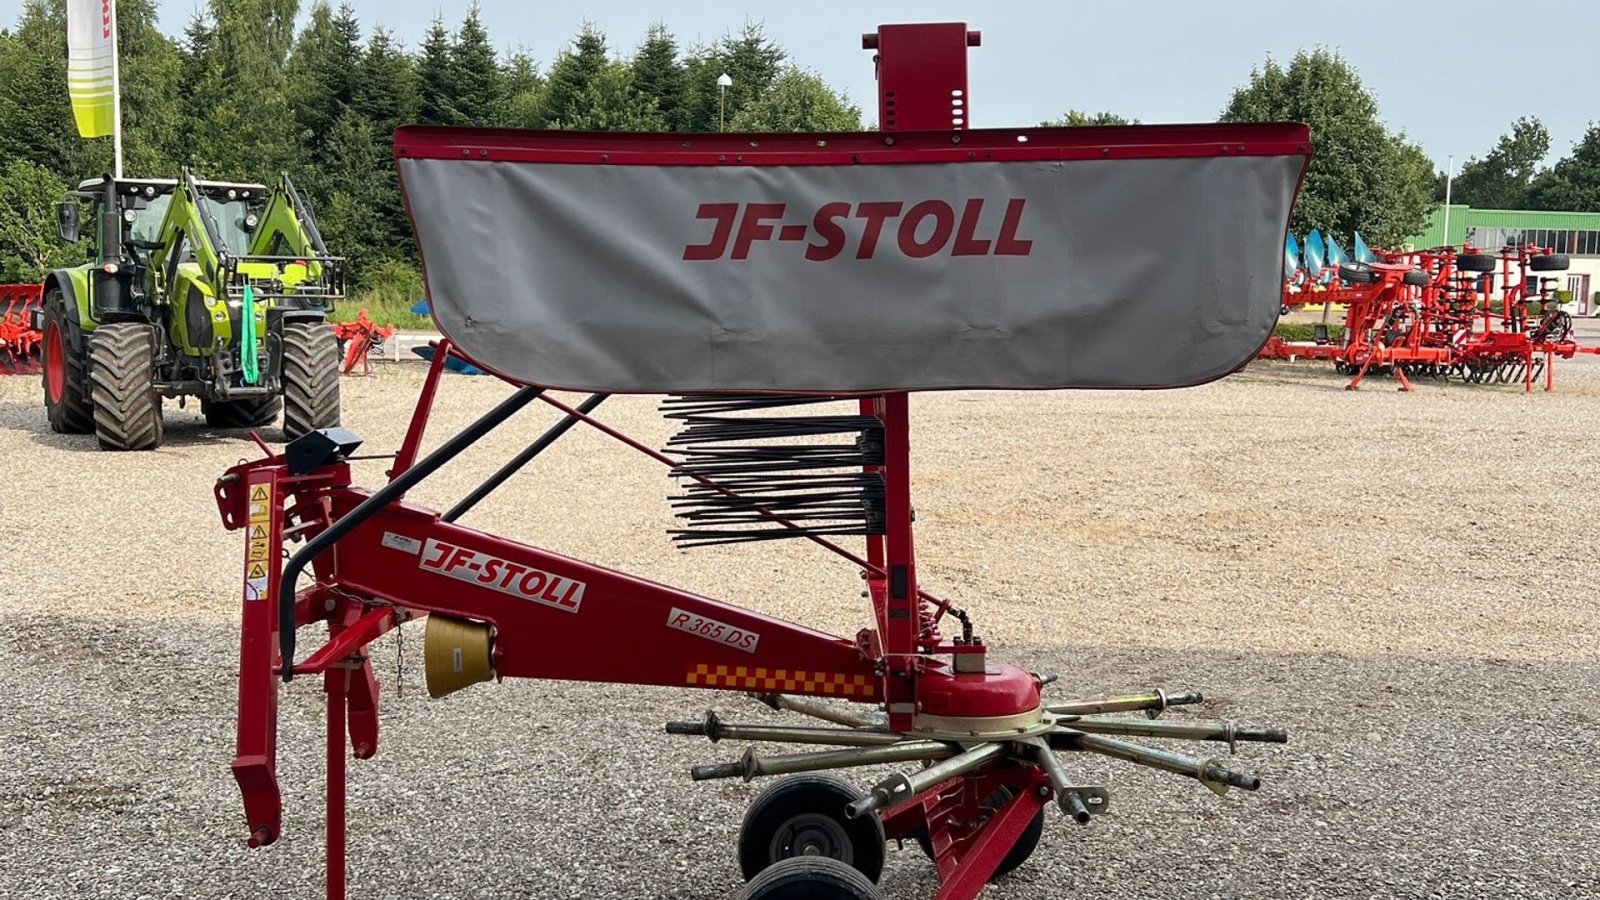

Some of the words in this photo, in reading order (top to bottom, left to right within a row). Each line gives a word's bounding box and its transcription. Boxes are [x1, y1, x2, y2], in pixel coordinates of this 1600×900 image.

[682, 198, 1033, 262] JF-STOLL
[423, 542, 581, 609] JF-STOLL
[670, 613, 691, 628] R
[689, 618, 726, 639] 365
[724, 630, 756, 649] DS
